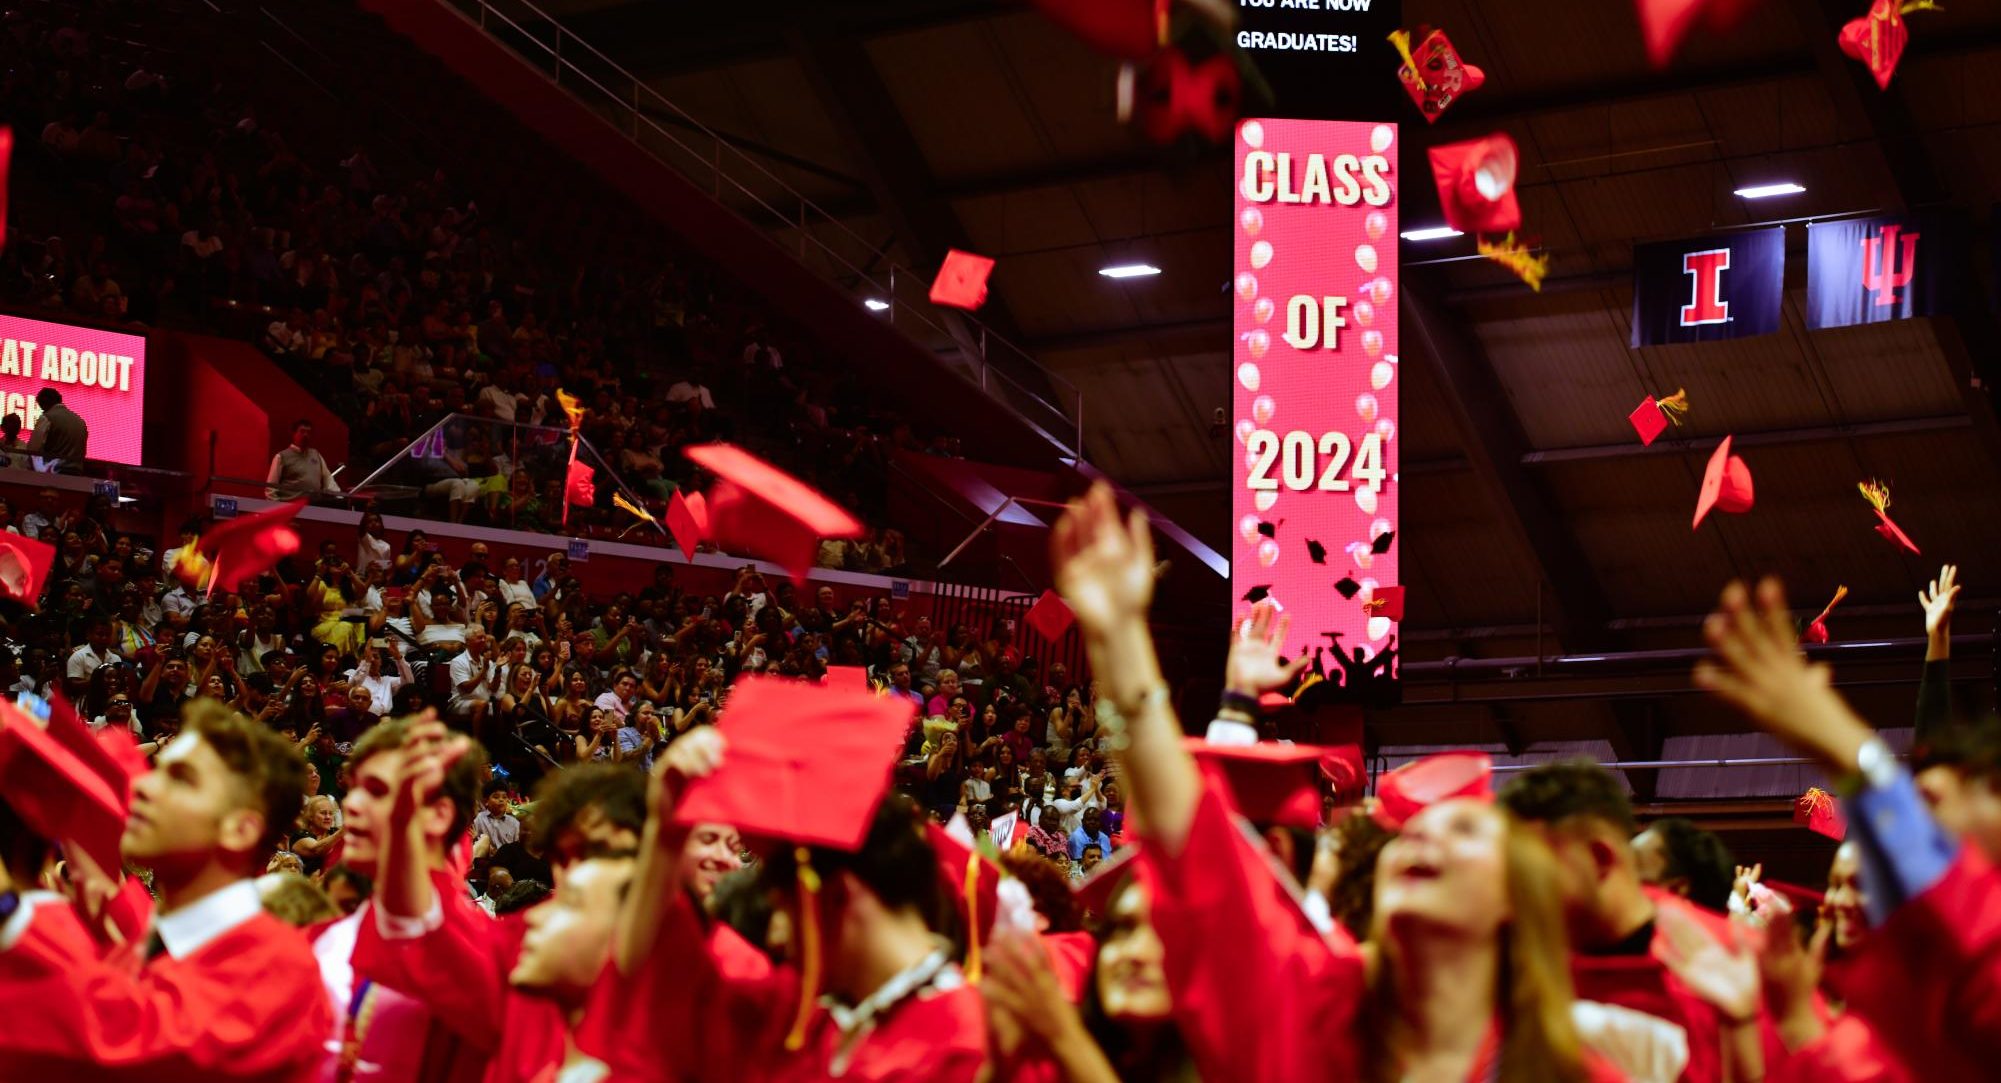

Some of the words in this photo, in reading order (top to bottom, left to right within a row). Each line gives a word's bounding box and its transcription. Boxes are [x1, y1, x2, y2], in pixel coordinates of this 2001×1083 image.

[1237, 31, 1358, 52] GRADUATES!
[1244, 150, 1392, 207] CLASS
[1680, 247, 1731, 327] I
[1286, 294, 1348, 350] OF
[0, 338, 38, 378] AT
[40, 343, 134, 391] ABOUT
[1246, 429, 1387, 493] 2024
